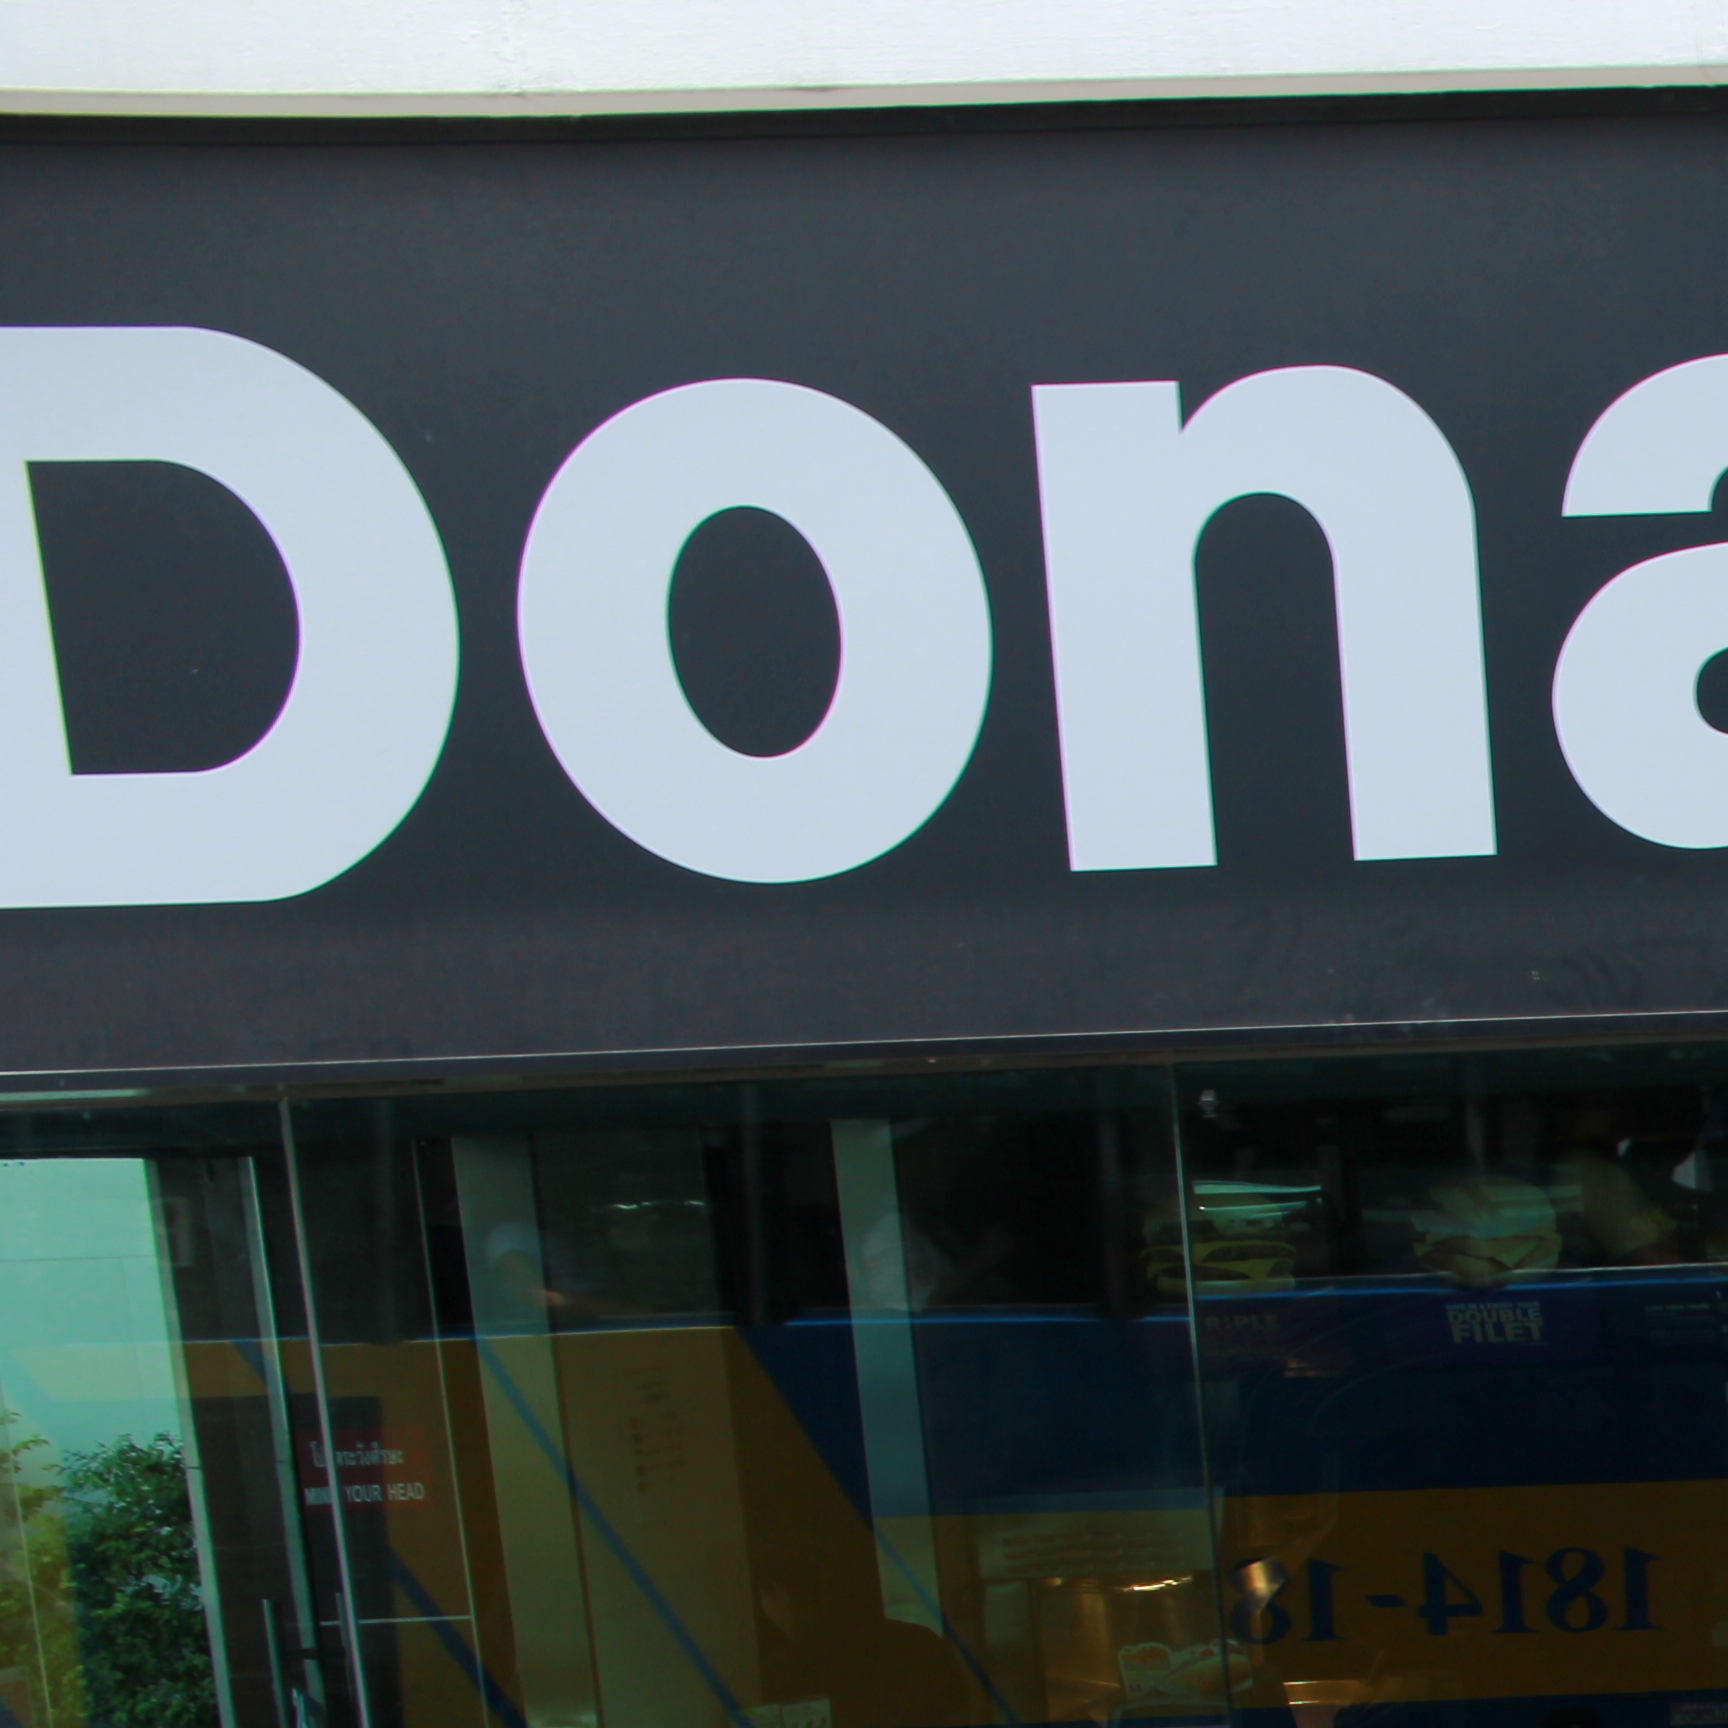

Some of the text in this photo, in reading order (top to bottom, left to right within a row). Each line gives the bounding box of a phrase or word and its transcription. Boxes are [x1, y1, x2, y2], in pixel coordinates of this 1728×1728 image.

[1447, 1307, 1543, 1324] DOUBLE
[1451, 1321, 1544, 1344] FILET
[344, 1484, 384, 1503] YOUR
[387, 1481, 426, 1502] HEAD
